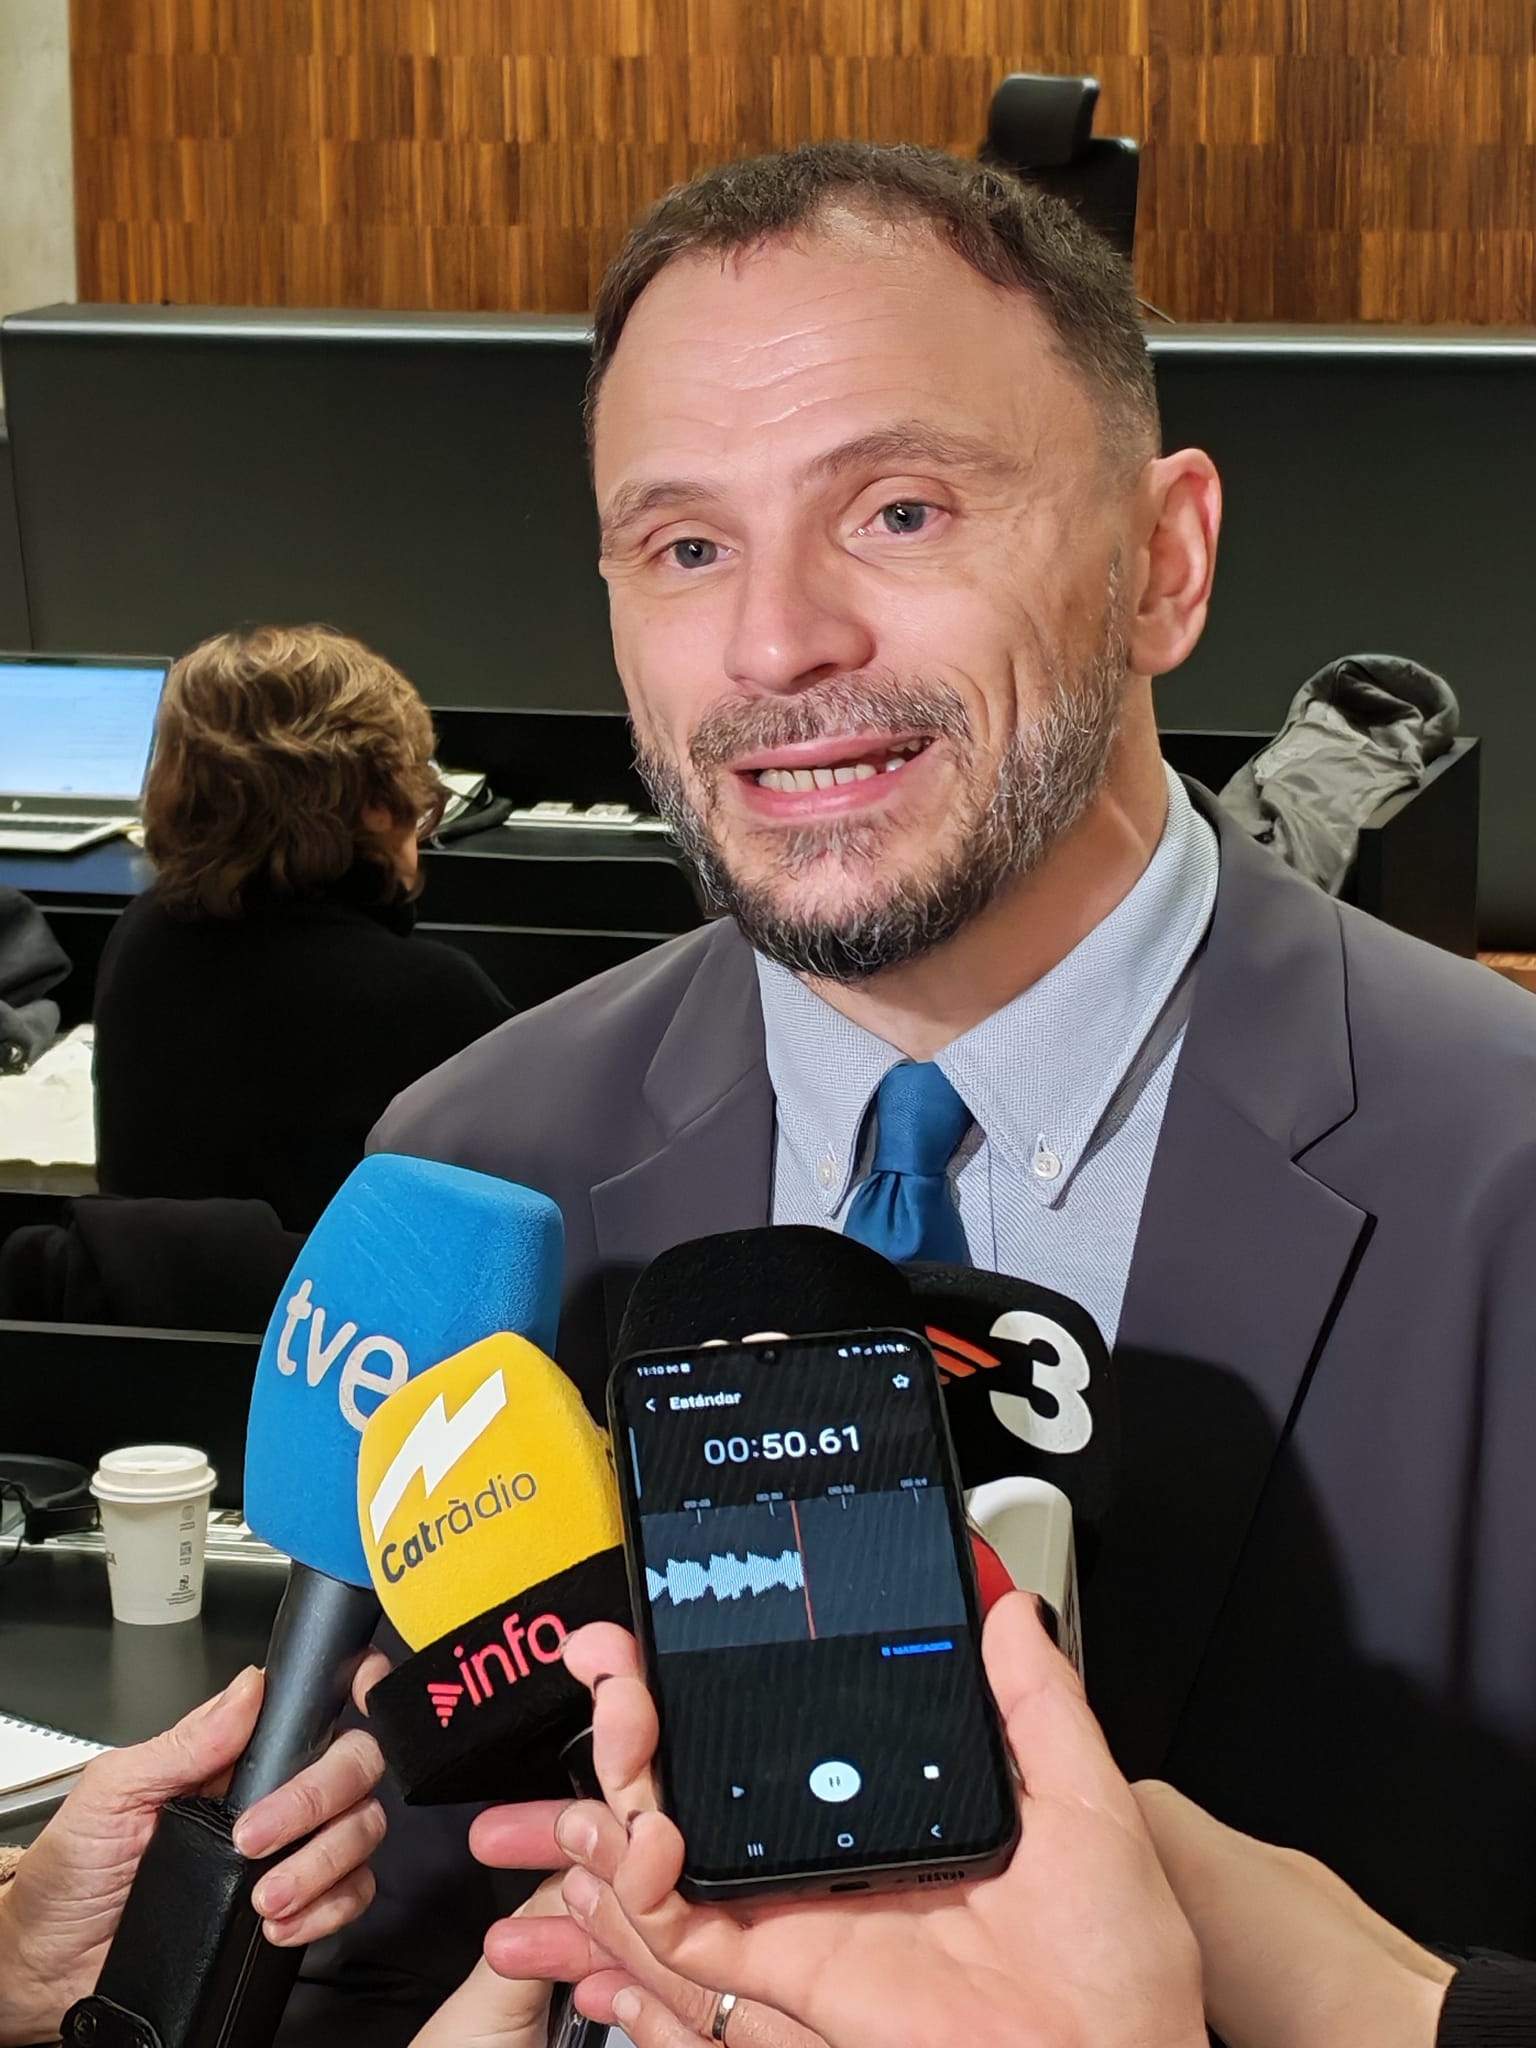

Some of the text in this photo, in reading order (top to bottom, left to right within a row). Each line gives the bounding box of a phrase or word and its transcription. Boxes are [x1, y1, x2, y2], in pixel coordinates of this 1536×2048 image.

[276, 1278, 410, 1434] tve
[669, 1391, 742, 1411] Estándar
[989, 1310, 1094, 1455] 3
[703, 1424, 862, 1466] 00:50.61
[380, 1471, 537, 1584] Catràdio
[453, 1612, 568, 1707] info
